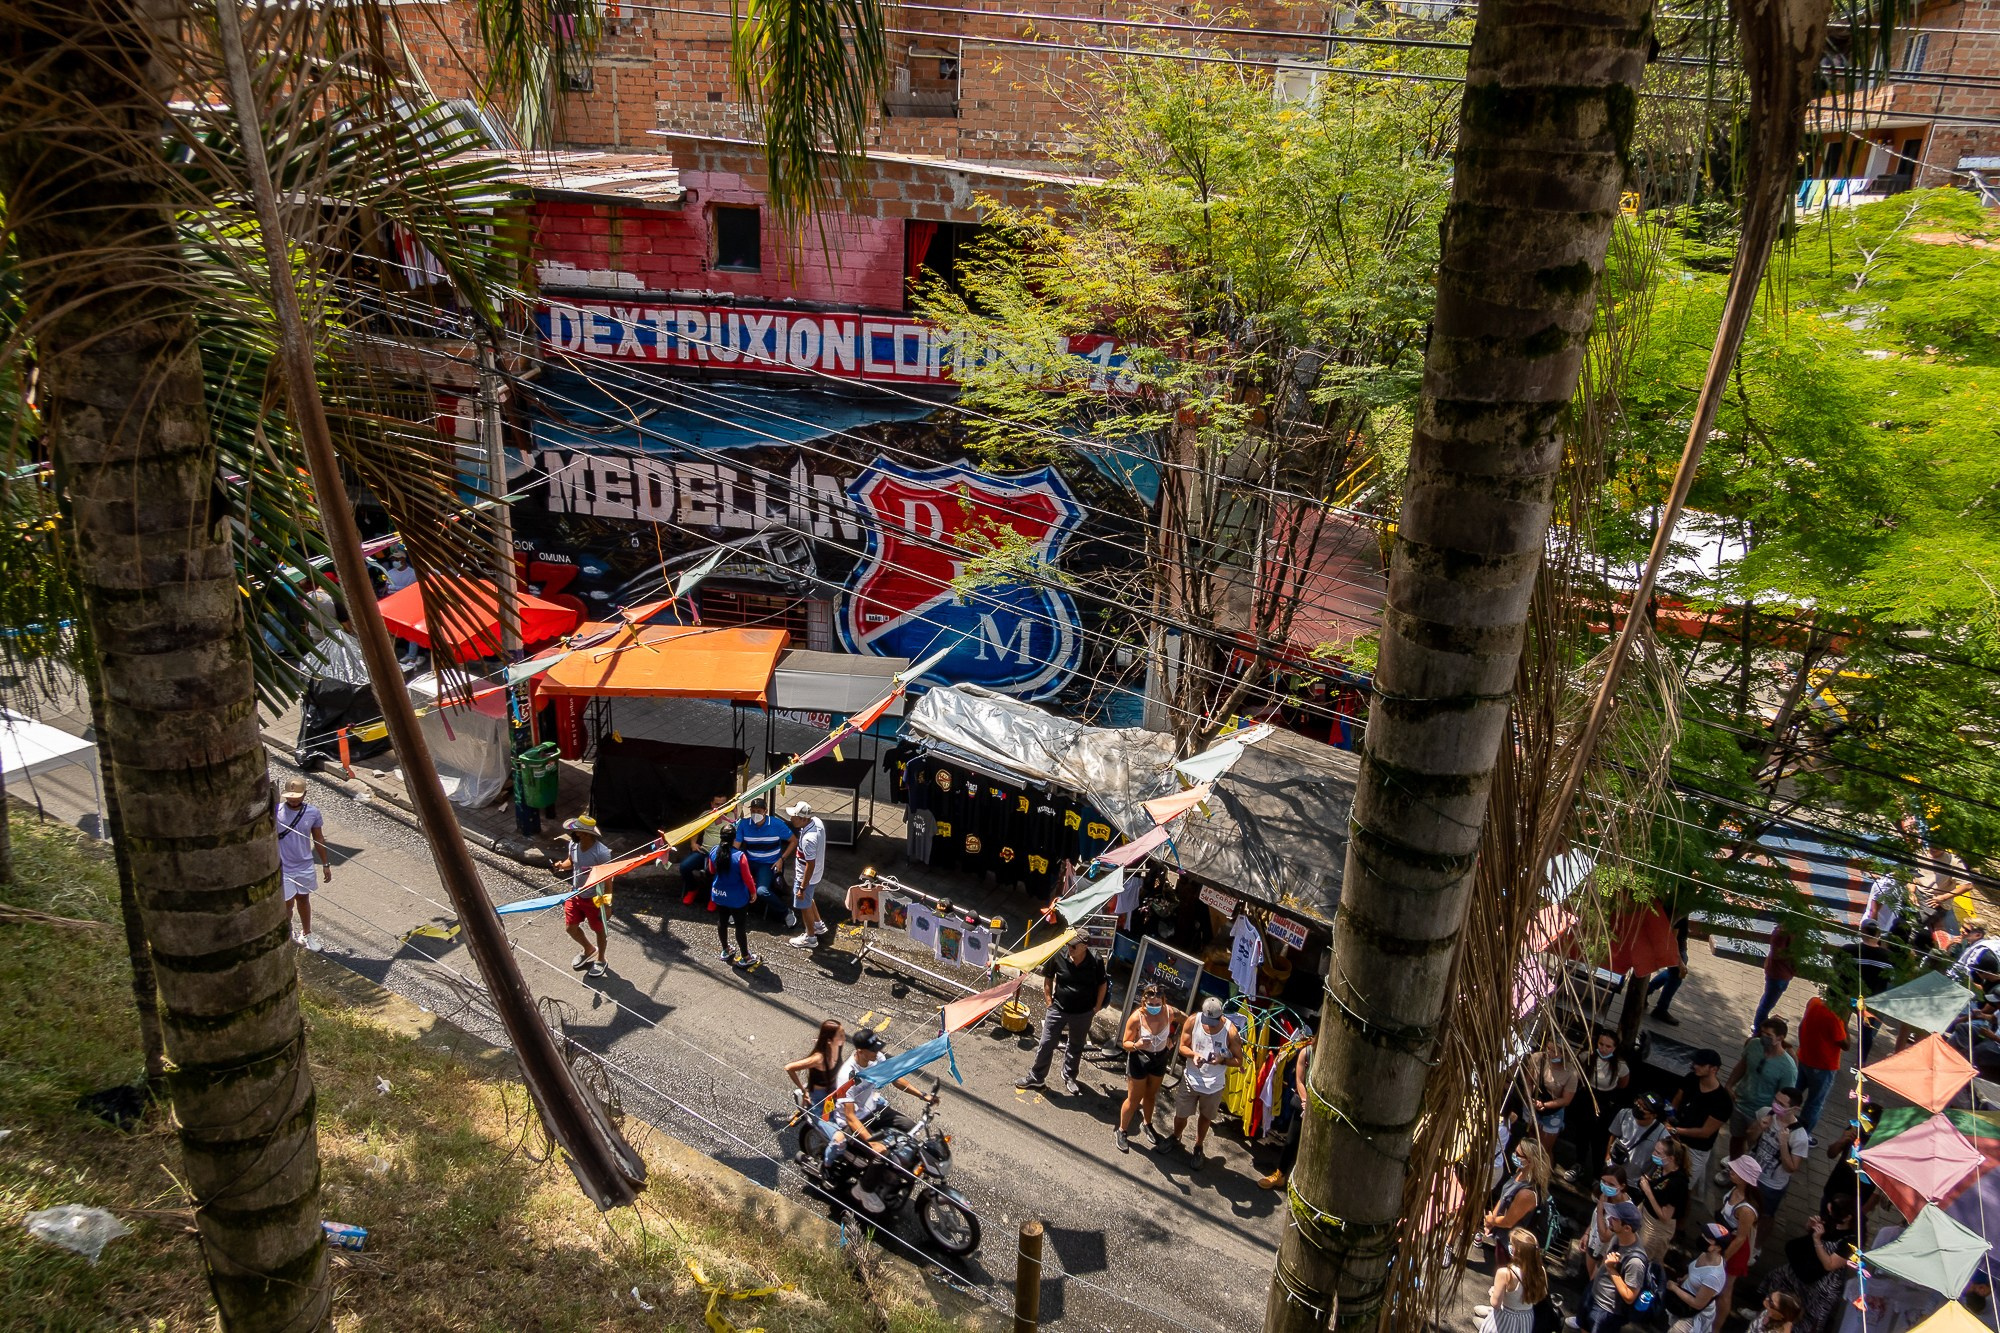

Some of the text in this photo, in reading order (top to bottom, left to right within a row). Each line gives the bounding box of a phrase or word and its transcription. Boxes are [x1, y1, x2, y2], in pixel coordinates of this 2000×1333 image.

[550, 302, 855, 371] DEXTRUXION
[539, 552, 571, 563] OMUNA
[974, 612, 1034, 664] M
[1267, 922, 1288, 939] SUGAR
[1153, 967, 1186, 988] ISTRICT
[1157, 962, 1179, 977] BOOK
